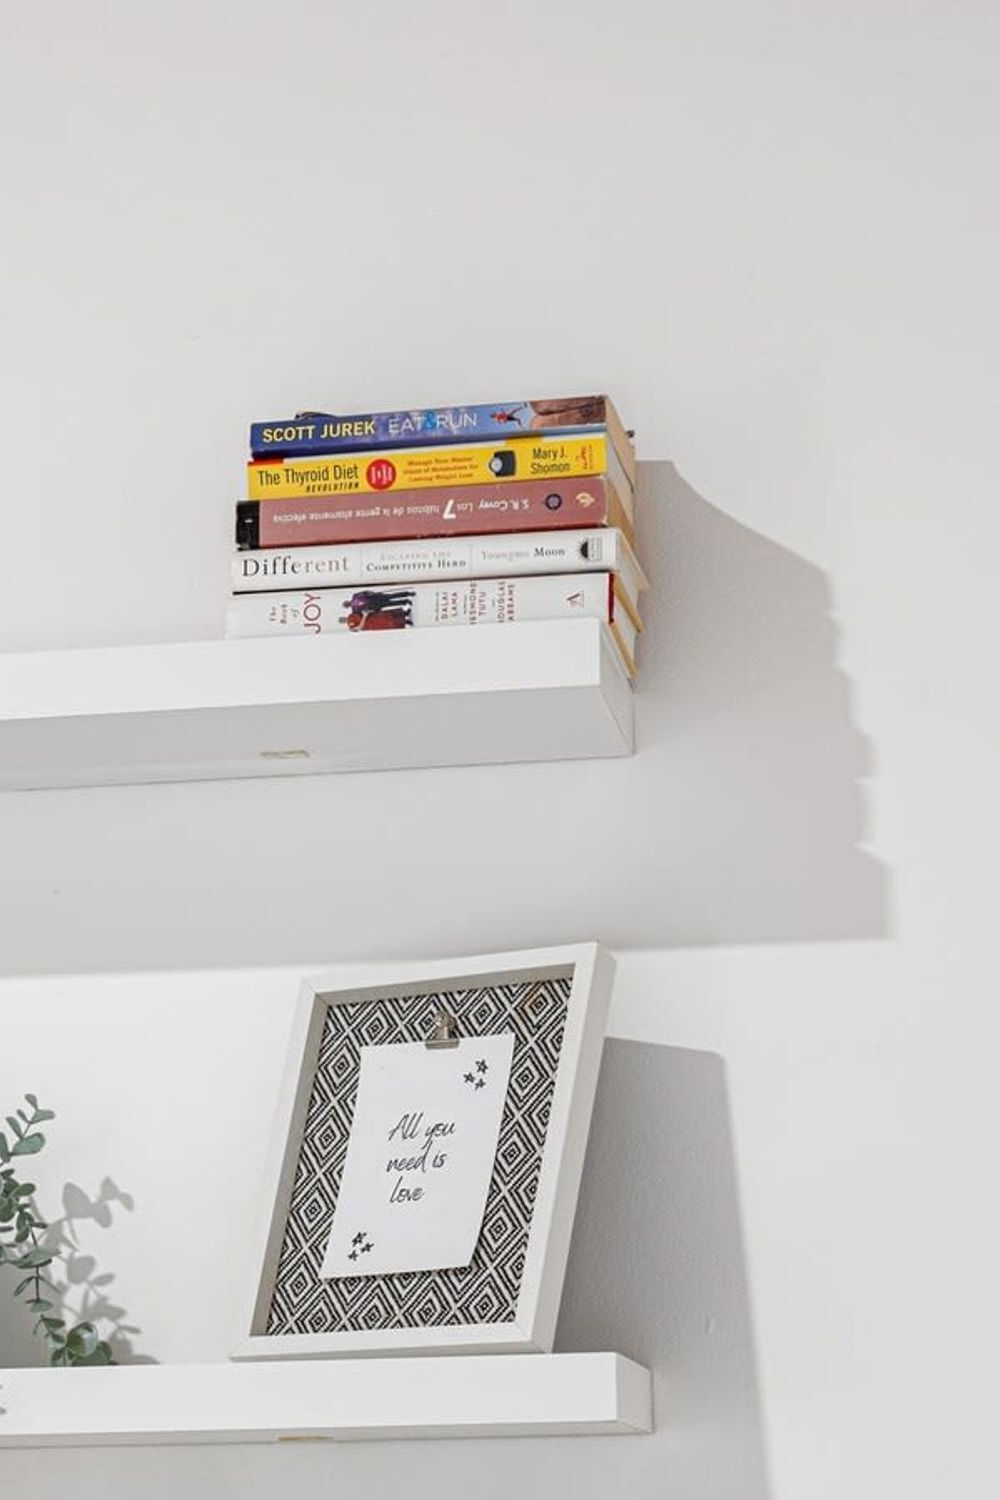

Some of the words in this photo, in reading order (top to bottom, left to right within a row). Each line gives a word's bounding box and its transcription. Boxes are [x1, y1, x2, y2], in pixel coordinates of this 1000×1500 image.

[263, 425, 315, 443] SCOTT
[320, 420, 375, 439] JUREK
[532, 446, 558, 462] Mary
[560, 445, 567, 459] J.
[258, 470, 281, 486] The
[284, 466, 329, 488] Thyroid
[333, 464, 359, 480] Diet
[531, 461, 571, 476] Shomon
[306, 482, 360, 493] REVOLUTION
[354, 508, 380, 519] gente
[392, 507, 405, 517] de
[443, 499, 457, 520] 7
[457, 501, 473, 512] Los
[478, 499, 508, 512] Covey
[534, 547, 566, 557] Moon
[242, 555, 349, 577] Different
[304, 593, 321, 634] JOY
[441, 591, 449, 620] DALAI
[388, 1112, 424, 1141] All
[421, 1122, 455, 1150] you
[386, 1140, 433, 1173] need
[432, 1150, 448, 1168] is
